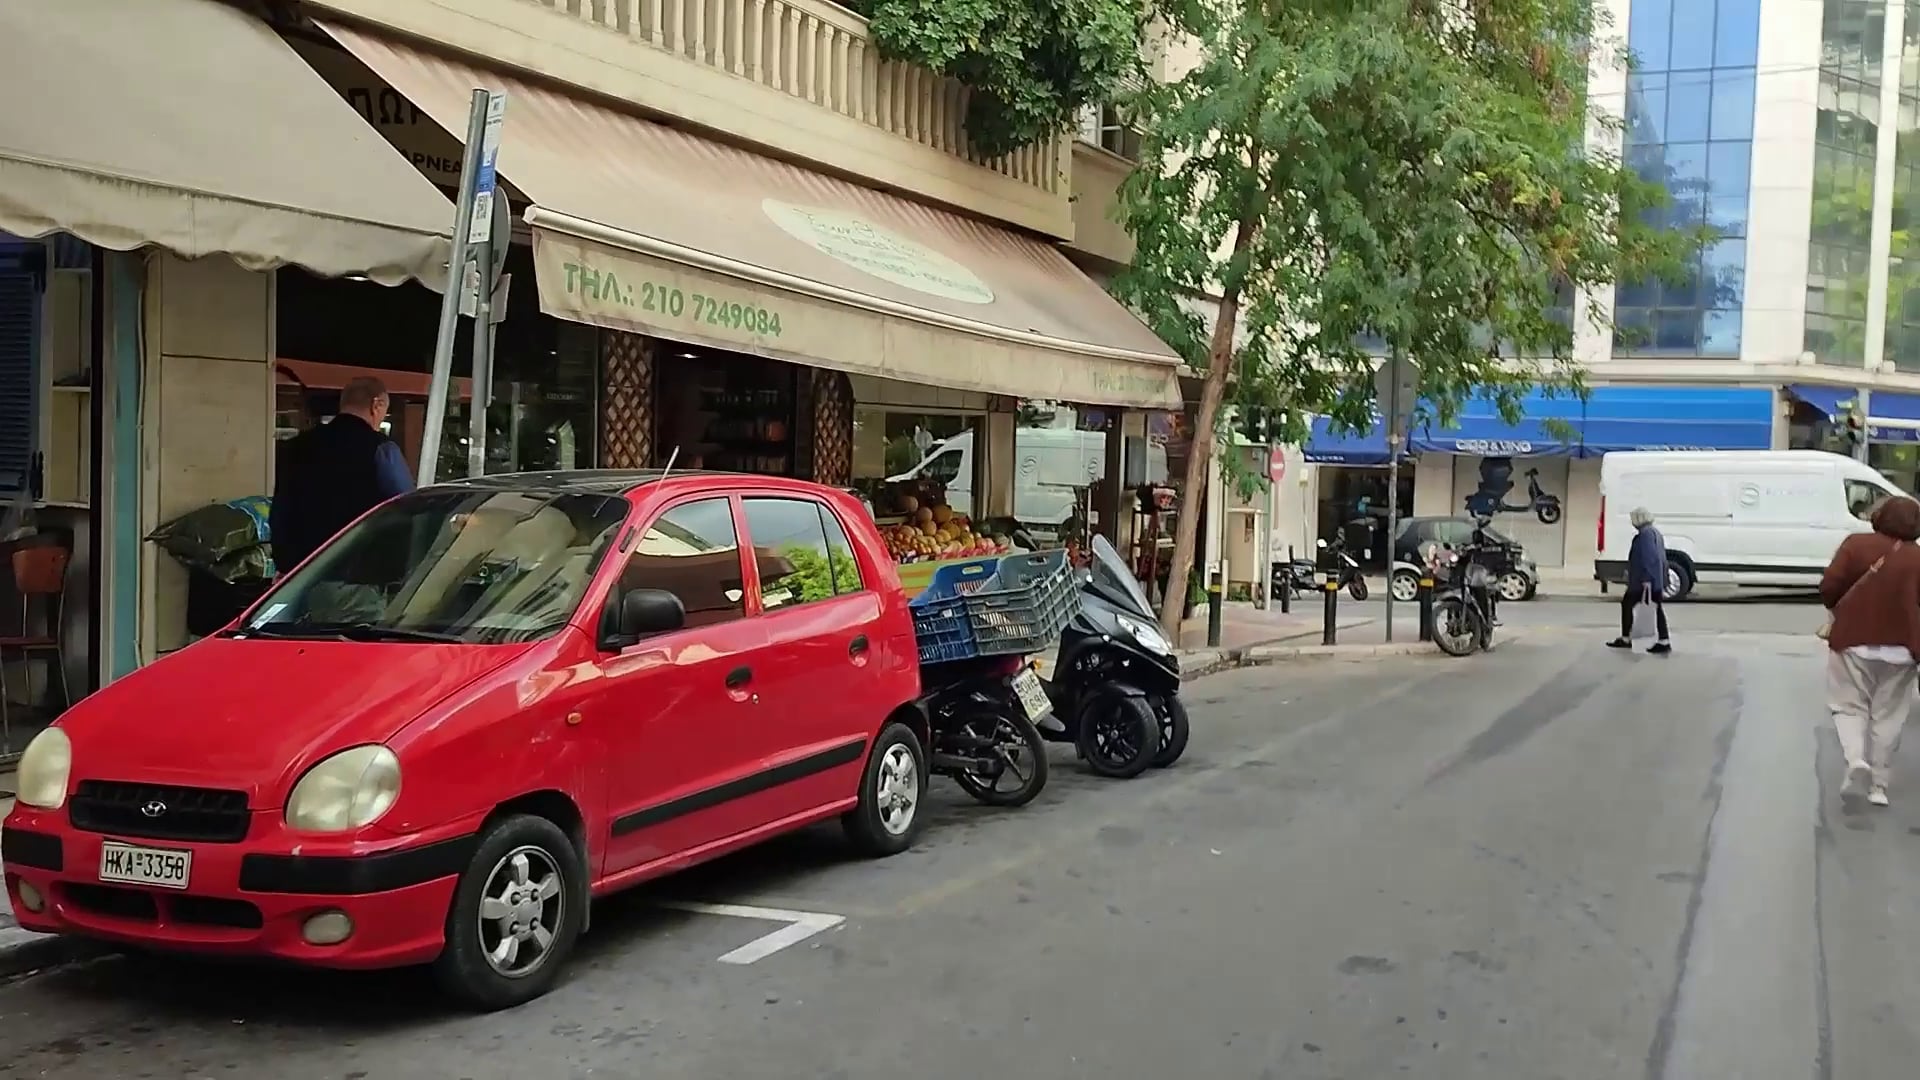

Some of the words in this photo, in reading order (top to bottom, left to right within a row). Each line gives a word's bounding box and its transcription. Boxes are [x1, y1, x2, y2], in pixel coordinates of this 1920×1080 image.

[563, 262, 635, 307] ΤΗΛ.:
[642, 282, 684, 317] 210
[692, 293, 782, 337] 7249084
[105, 850, 185, 880] HKA-3358
